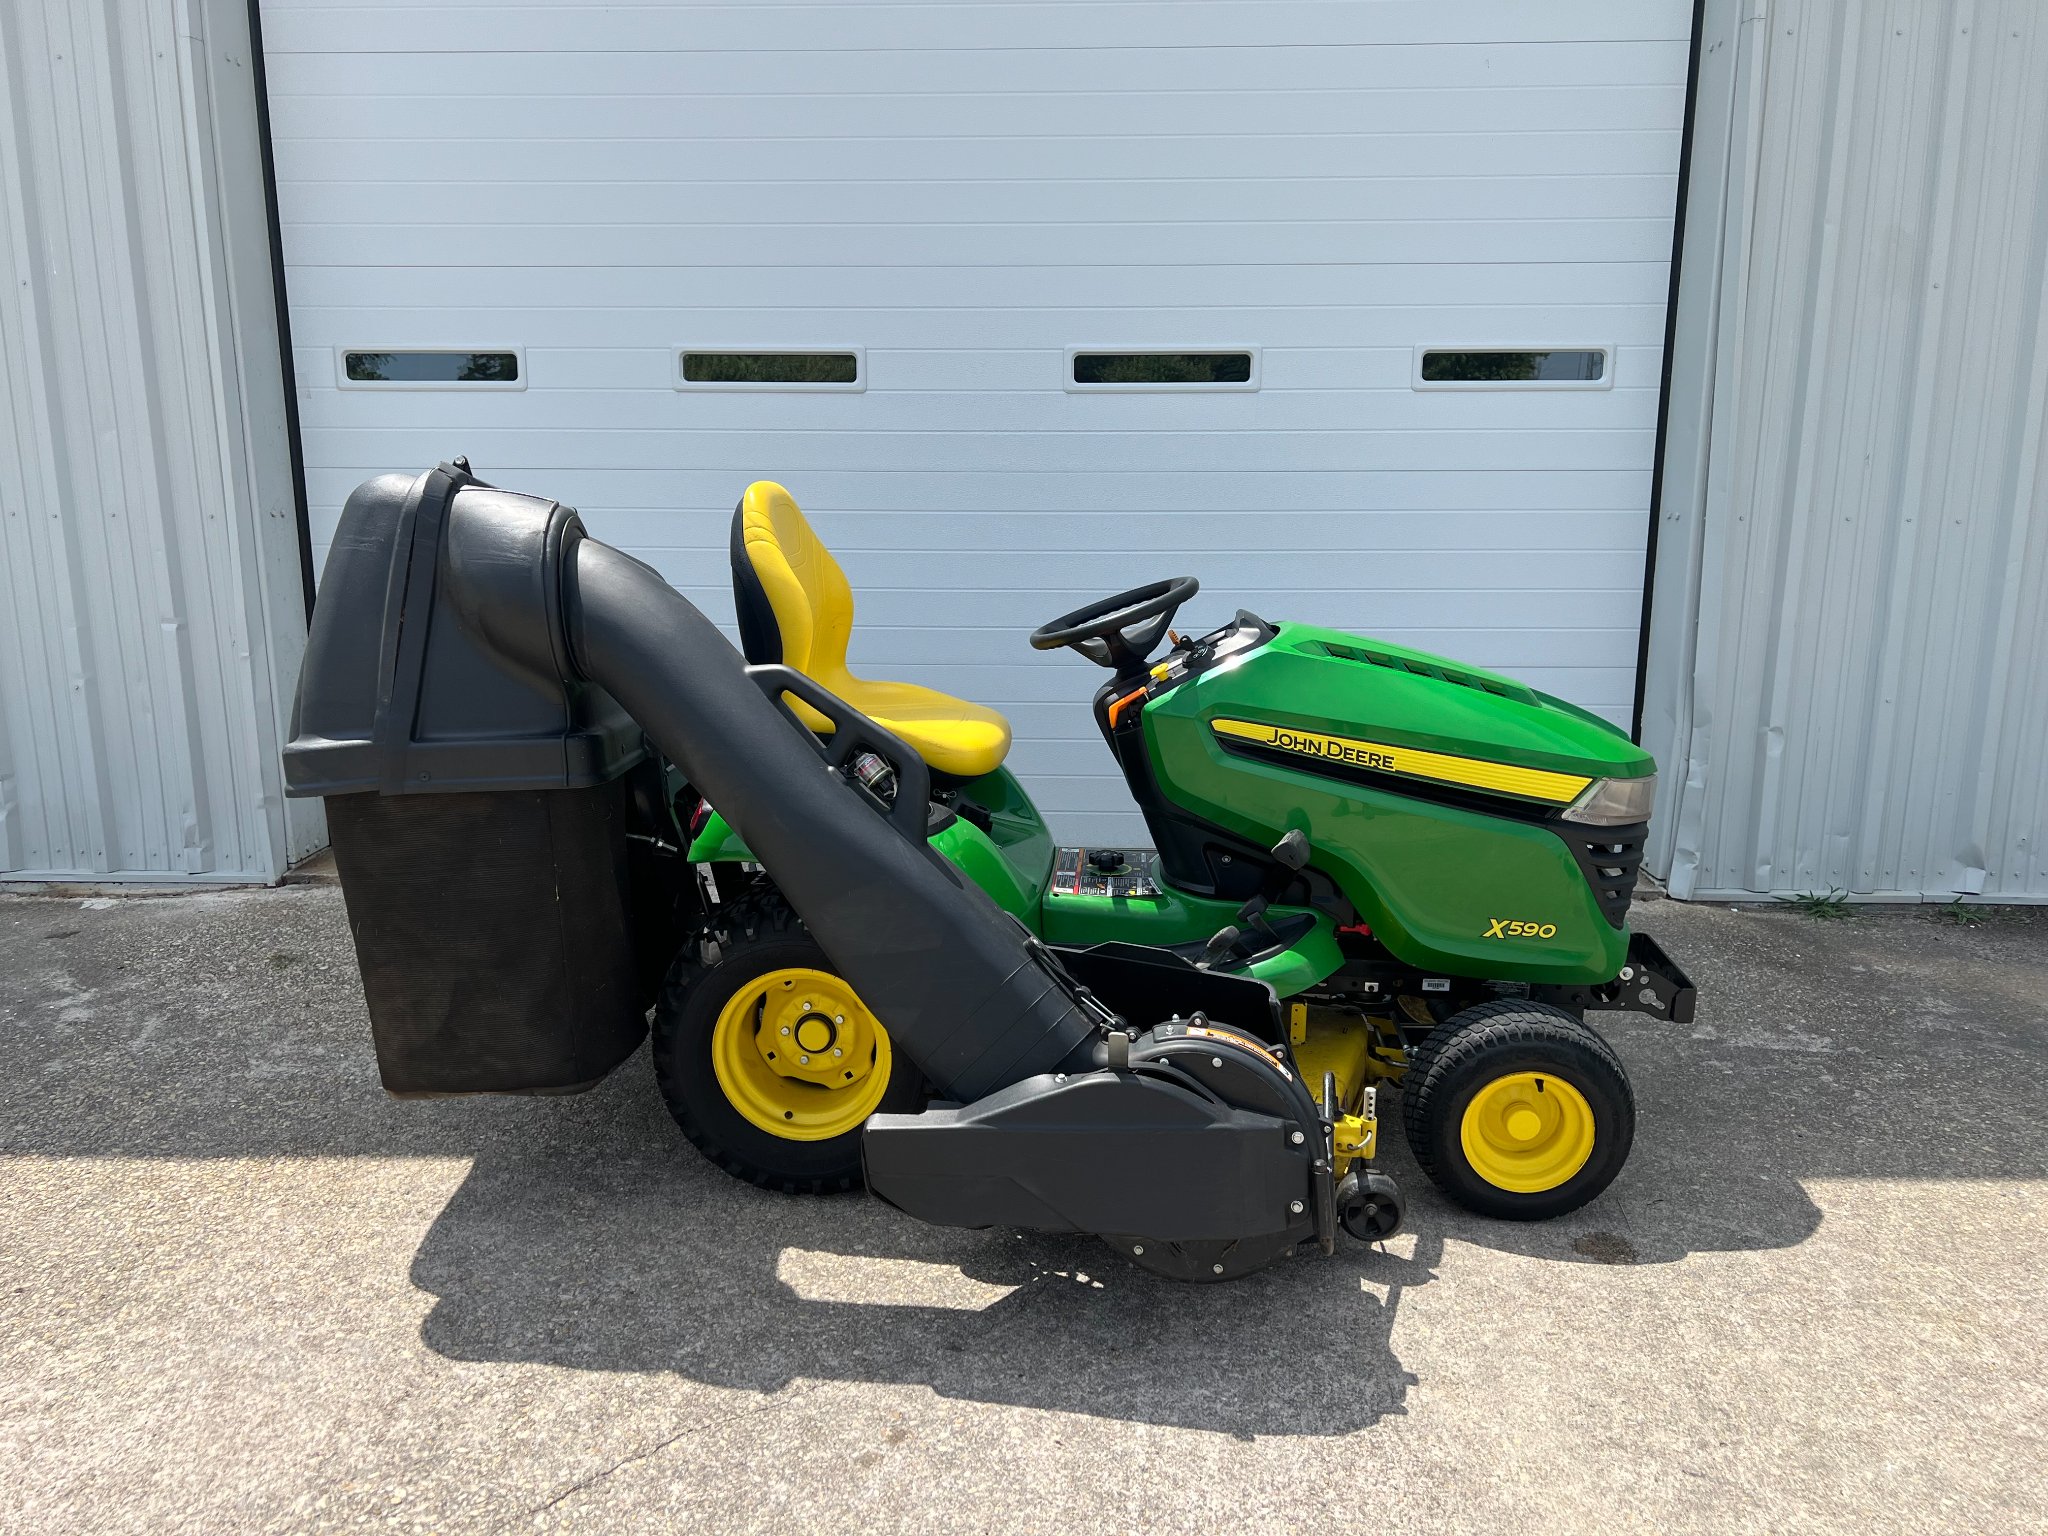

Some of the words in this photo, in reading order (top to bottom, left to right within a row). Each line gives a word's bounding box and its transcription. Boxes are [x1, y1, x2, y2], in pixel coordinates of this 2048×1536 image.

[1266, 728, 1322, 755] JOHN
[1326, 739, 1396, 770] DEERE
[1482, 918, 1557, 939] X590
